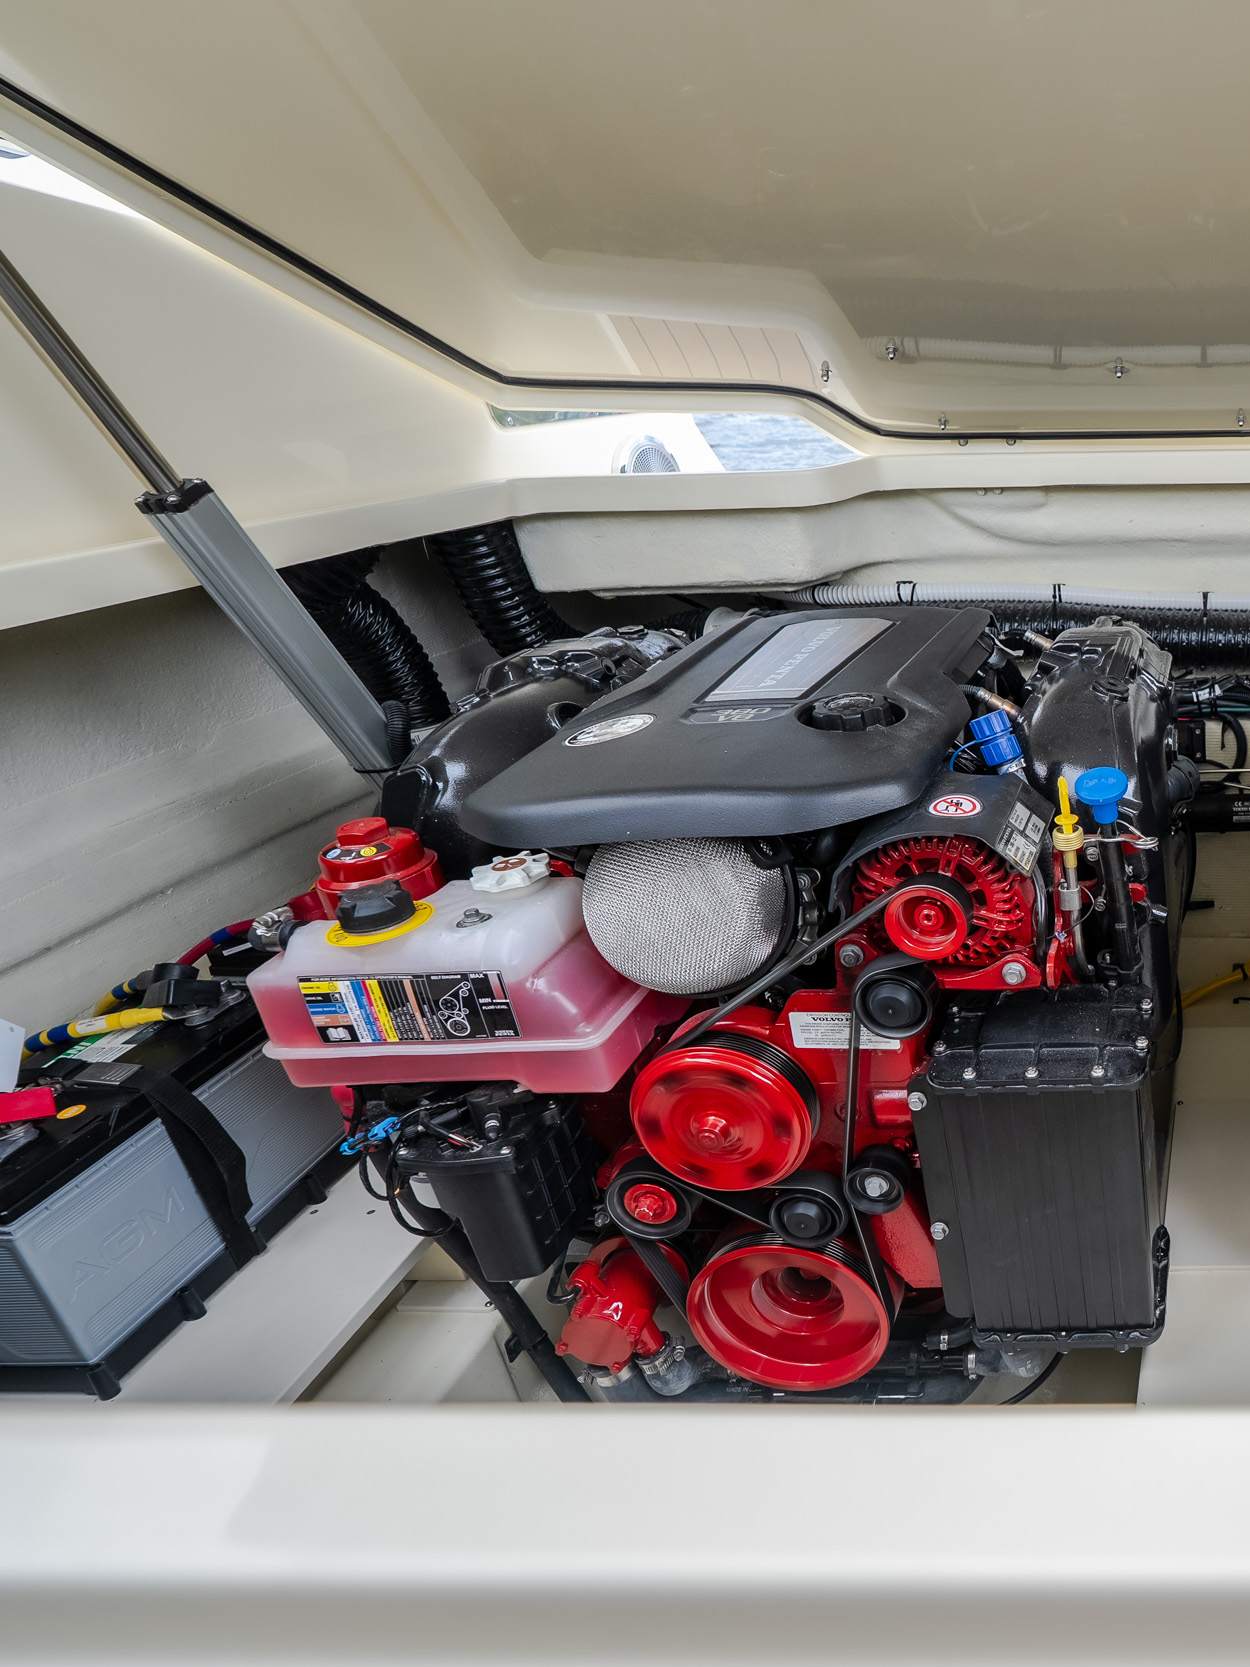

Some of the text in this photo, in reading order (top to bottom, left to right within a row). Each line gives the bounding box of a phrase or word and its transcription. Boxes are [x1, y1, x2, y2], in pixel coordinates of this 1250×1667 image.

[758, 624, 842, 688] VOLVO PENTA
[67, 1186, 185, 1305] AGM
